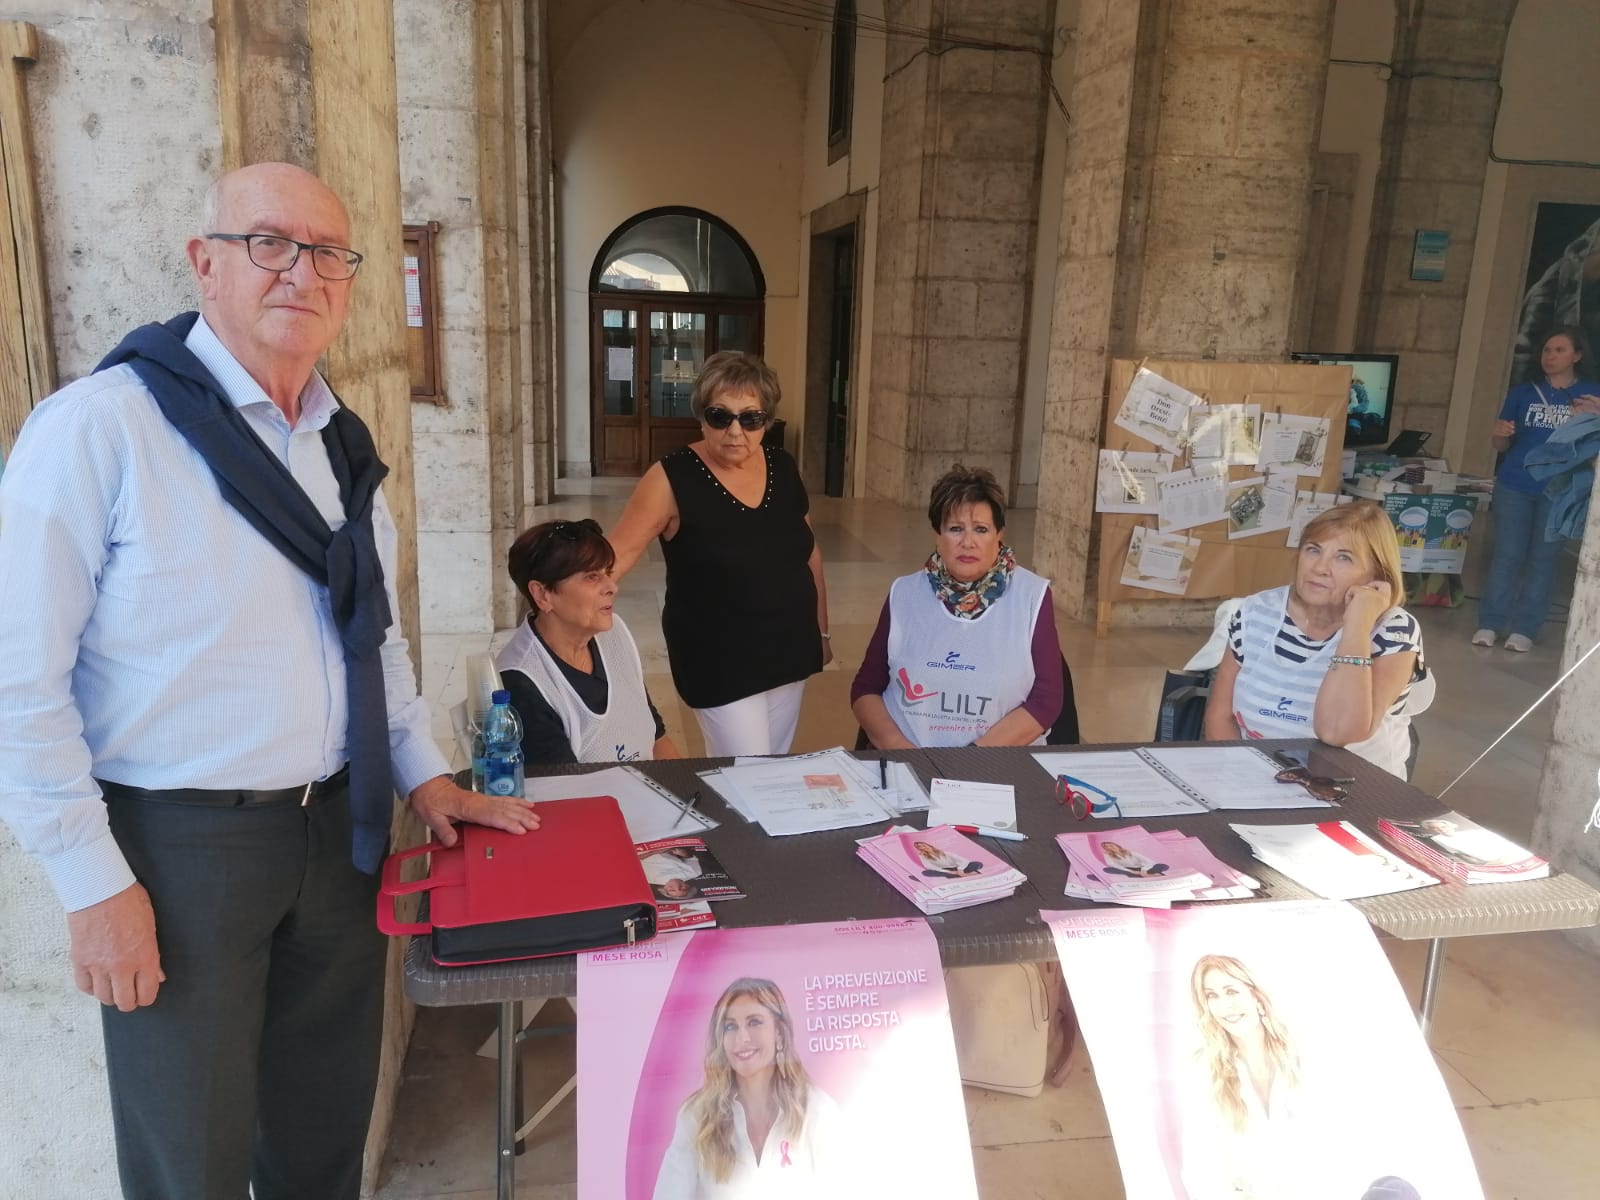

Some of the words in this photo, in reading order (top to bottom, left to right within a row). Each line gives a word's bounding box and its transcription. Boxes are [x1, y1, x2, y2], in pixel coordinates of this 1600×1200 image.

[926, 661, 977, 671] GIMER
[940, 691, 993, 716] LILT
[1258, 708, 1308, 722] GIMER
[1066, 929, 1097, 940] MESE
[592, 953, 626, 962] MESE
[630, 950, 662, 960] ROSA
[804, 975, 823, 991] LA
[825, 968, 927, 989] PREVENZIONE
[805, 992, 816, 1012] È
[817, 992, 880, 1011] SEMPRE
[806, 1016, 826, 1033] LA
[827, 1010, 900, 1031] RISPOSTA
[808, 1033, 865, 1052] GIUSTA.
